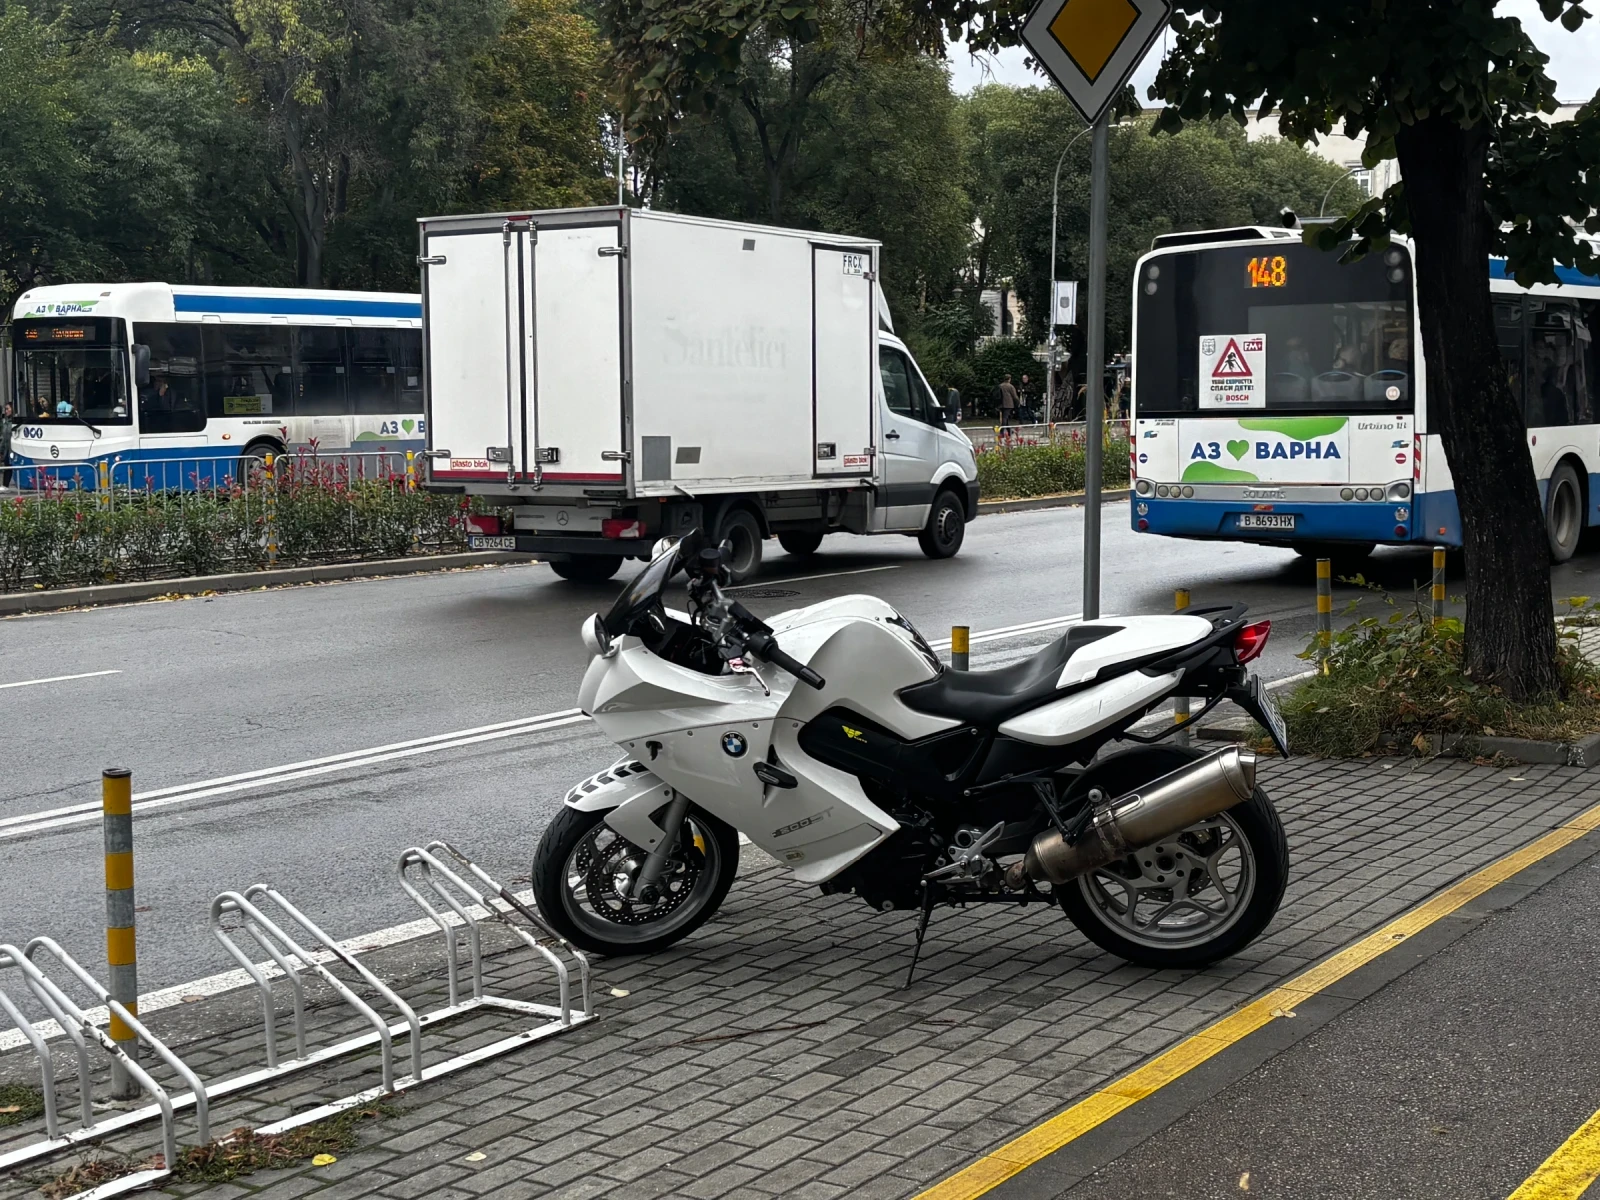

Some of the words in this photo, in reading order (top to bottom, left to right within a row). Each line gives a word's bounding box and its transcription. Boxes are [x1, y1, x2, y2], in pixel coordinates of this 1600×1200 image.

[843, 255, 862, 268] FRCX
[1247, 256, 1286, 287] 148
[55, 304, 82, 313] ВАРНА
[380, 421, 399, 434] АЗ
[1358, 422, 1394, 430] Urbino
[1190, 442, 1221, 460] АЗ
[1255, 441, 1341, 460] ВАРНА
[452, 460, 473, 468] plasto
[1243, 490, 1286, 499] SOLARIS
